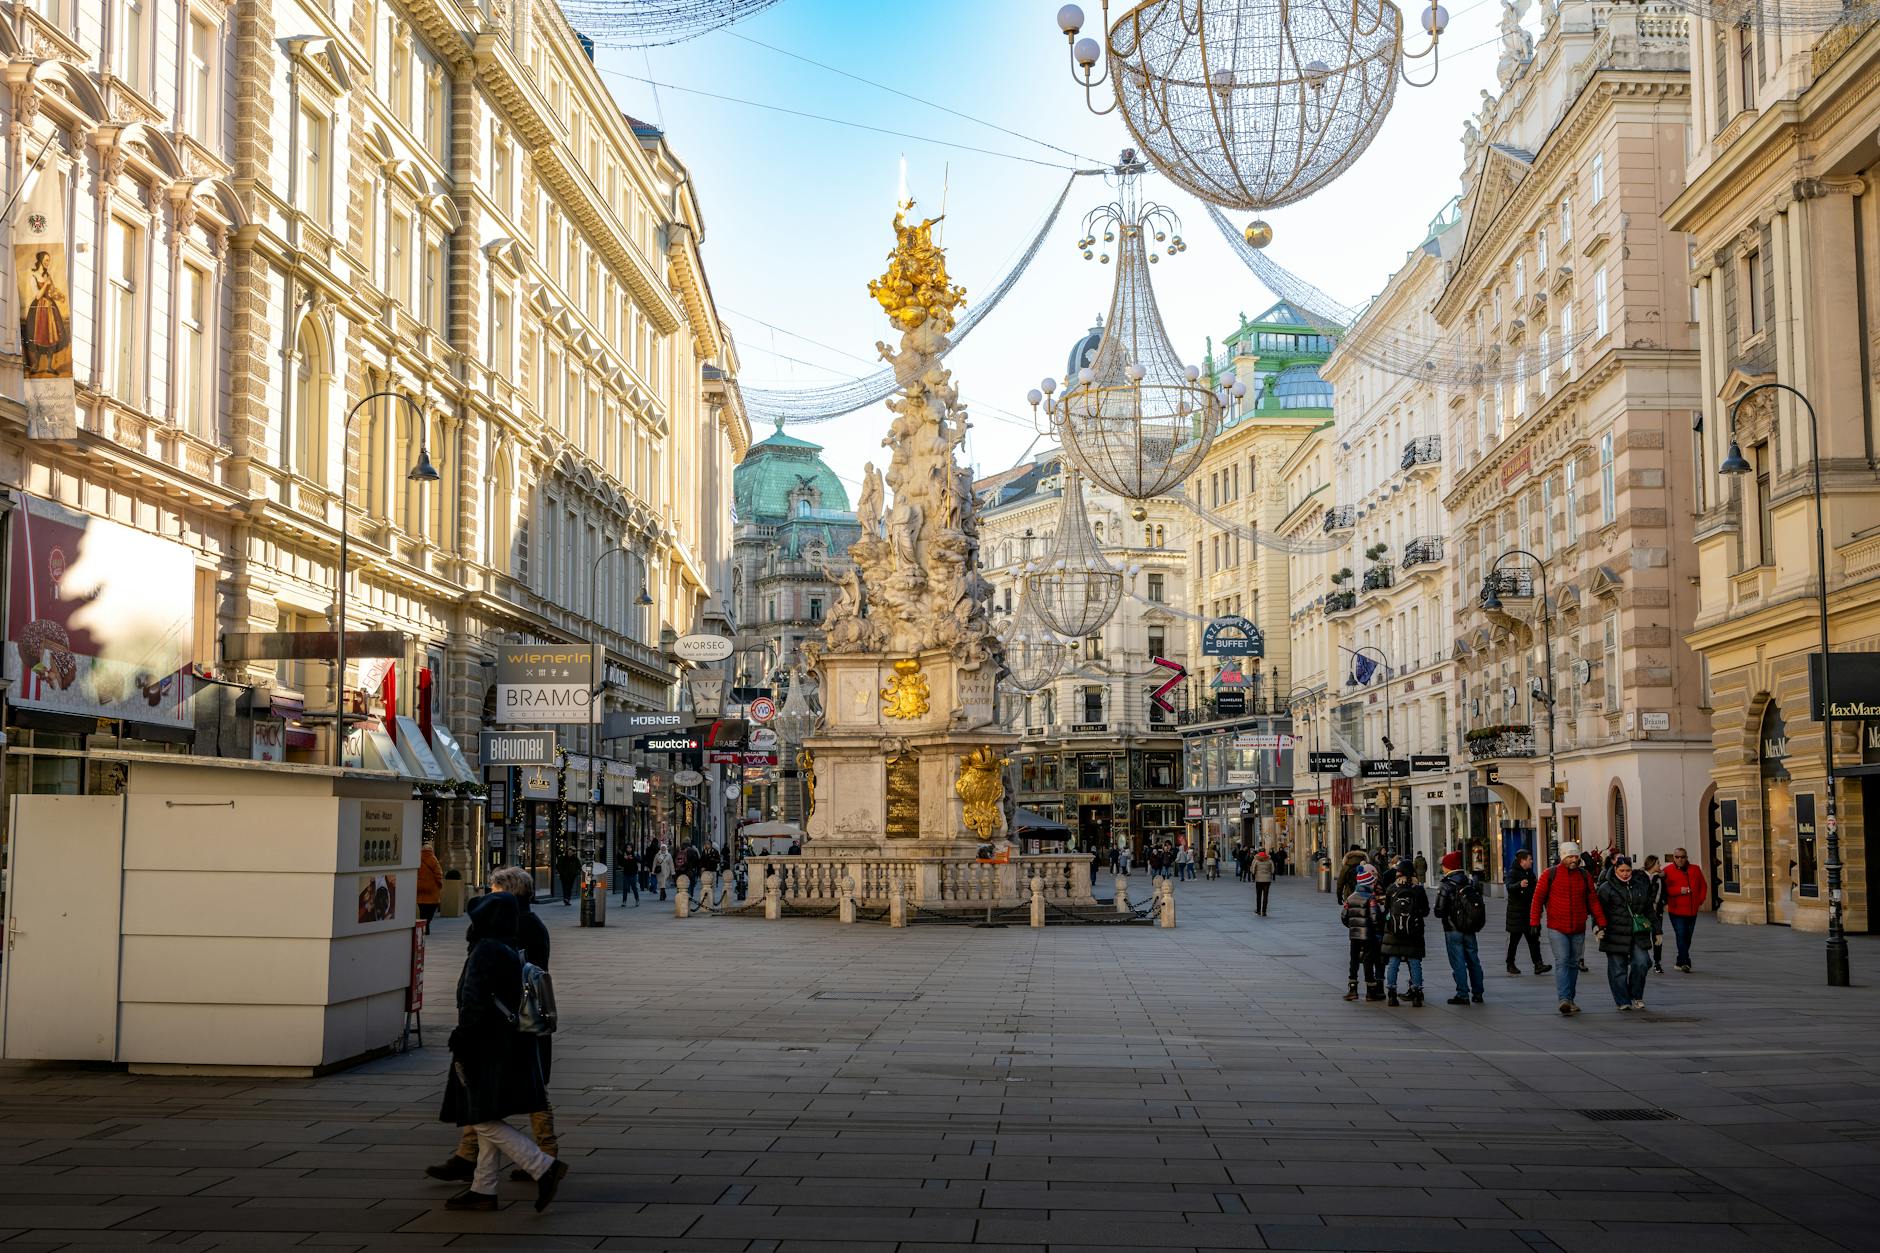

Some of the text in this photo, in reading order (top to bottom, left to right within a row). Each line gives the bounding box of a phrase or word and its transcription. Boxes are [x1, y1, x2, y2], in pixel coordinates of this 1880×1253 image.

[1216, 640, 1248, 648] BUFFET
[507, 652, 591, 664] wienerin
[255, 724, 282, 747] FRICK
[648, 739, 690, 749] swatch
[1373, 762, 1392, 770] IWC
